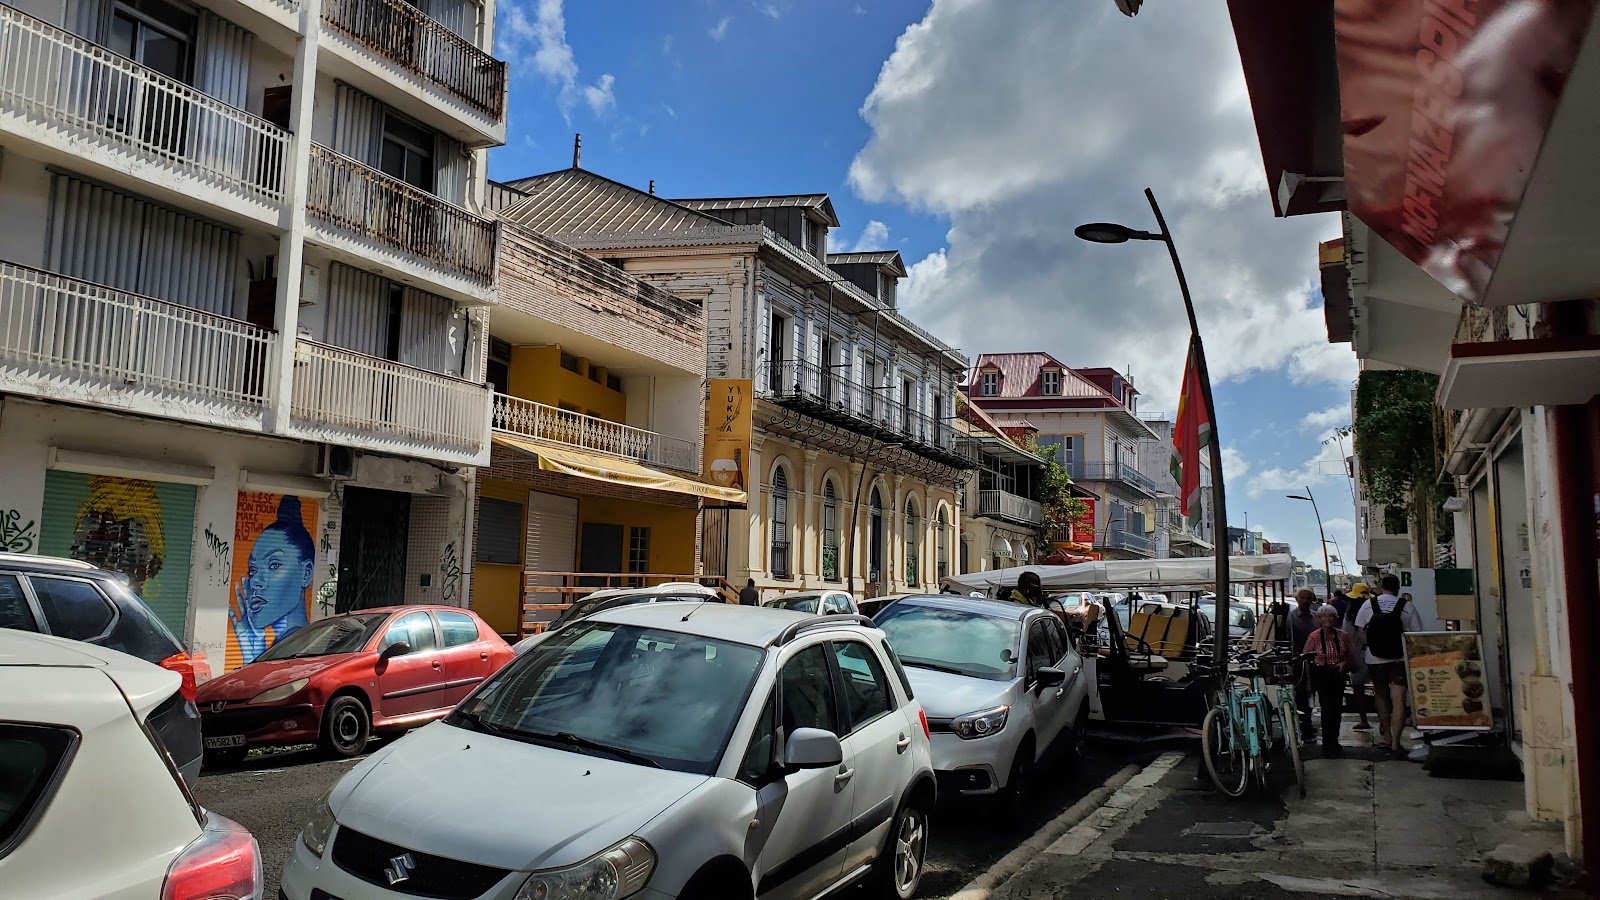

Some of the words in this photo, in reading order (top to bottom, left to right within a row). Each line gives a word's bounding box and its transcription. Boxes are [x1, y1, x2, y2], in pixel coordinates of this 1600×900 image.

[726, 386, 735, 432] YUKKA
[238, 491, 248, 501] PA
[237, 502, 254, 512] PON
[255, 503, 277, 514] MOUN
[235, 521, 264, 533] LISTWA
